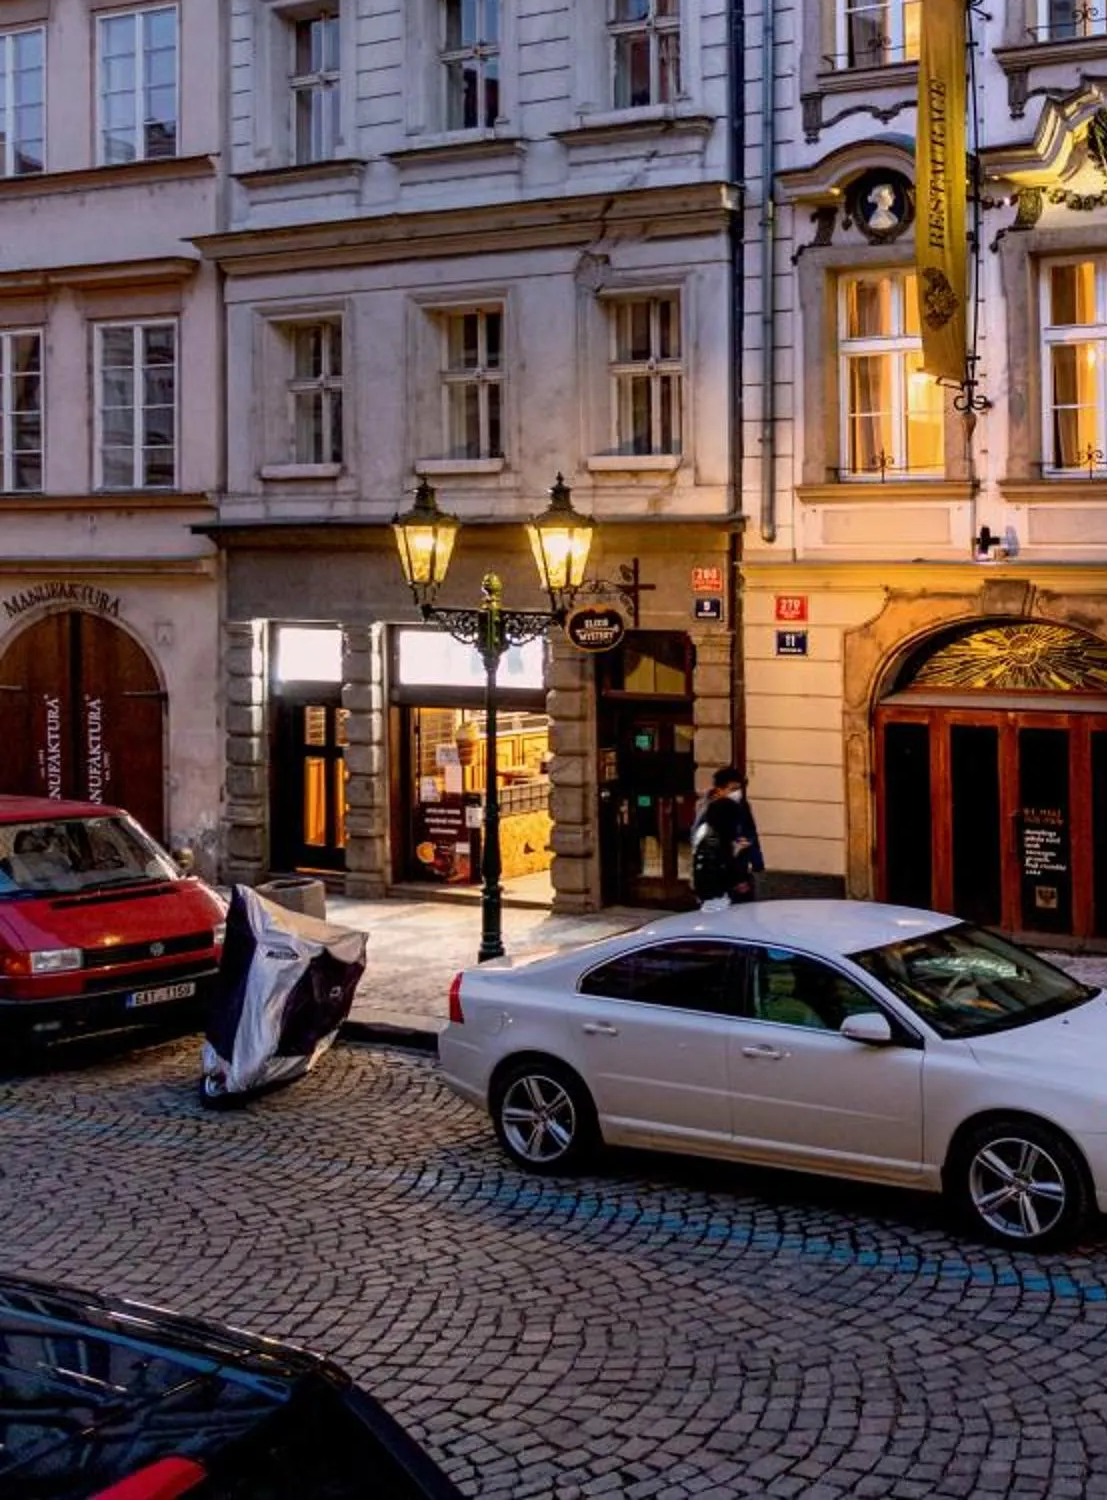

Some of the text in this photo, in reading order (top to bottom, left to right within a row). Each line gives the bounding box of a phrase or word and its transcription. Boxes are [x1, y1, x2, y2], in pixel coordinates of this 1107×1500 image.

[927, 78, 947, 250] RESTAURACE
[2, 581, 121, 618] MANUFAKTURA
[785, 633, 796, 647] 11
[47, 698, 62, 801] NUFAKTURA
[87, 698, 103, 805] NUFAKTURA
